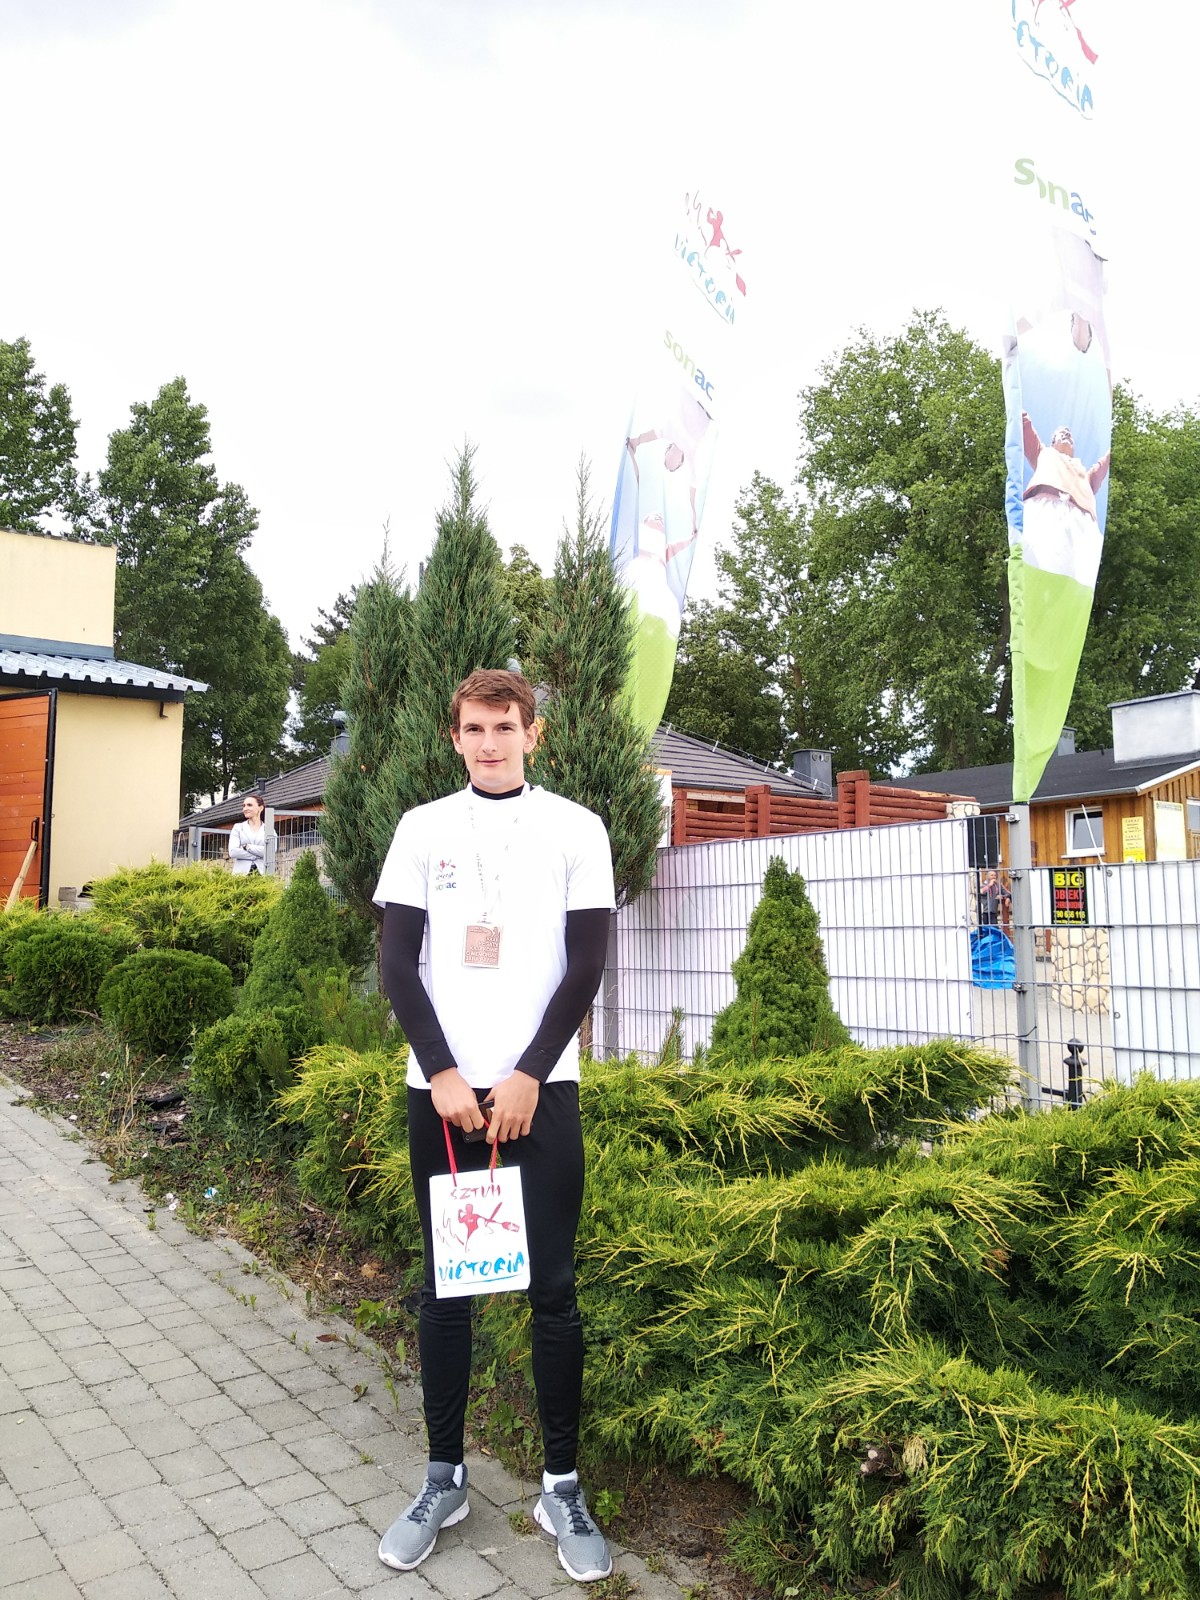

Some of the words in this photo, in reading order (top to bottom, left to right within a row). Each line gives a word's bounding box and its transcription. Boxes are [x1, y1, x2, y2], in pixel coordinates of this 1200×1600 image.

[664, 330, 715, 401] sonac
[1054, 873, 1084, 886] BIG
[1054, 889, 1085, 900] OBEKT
